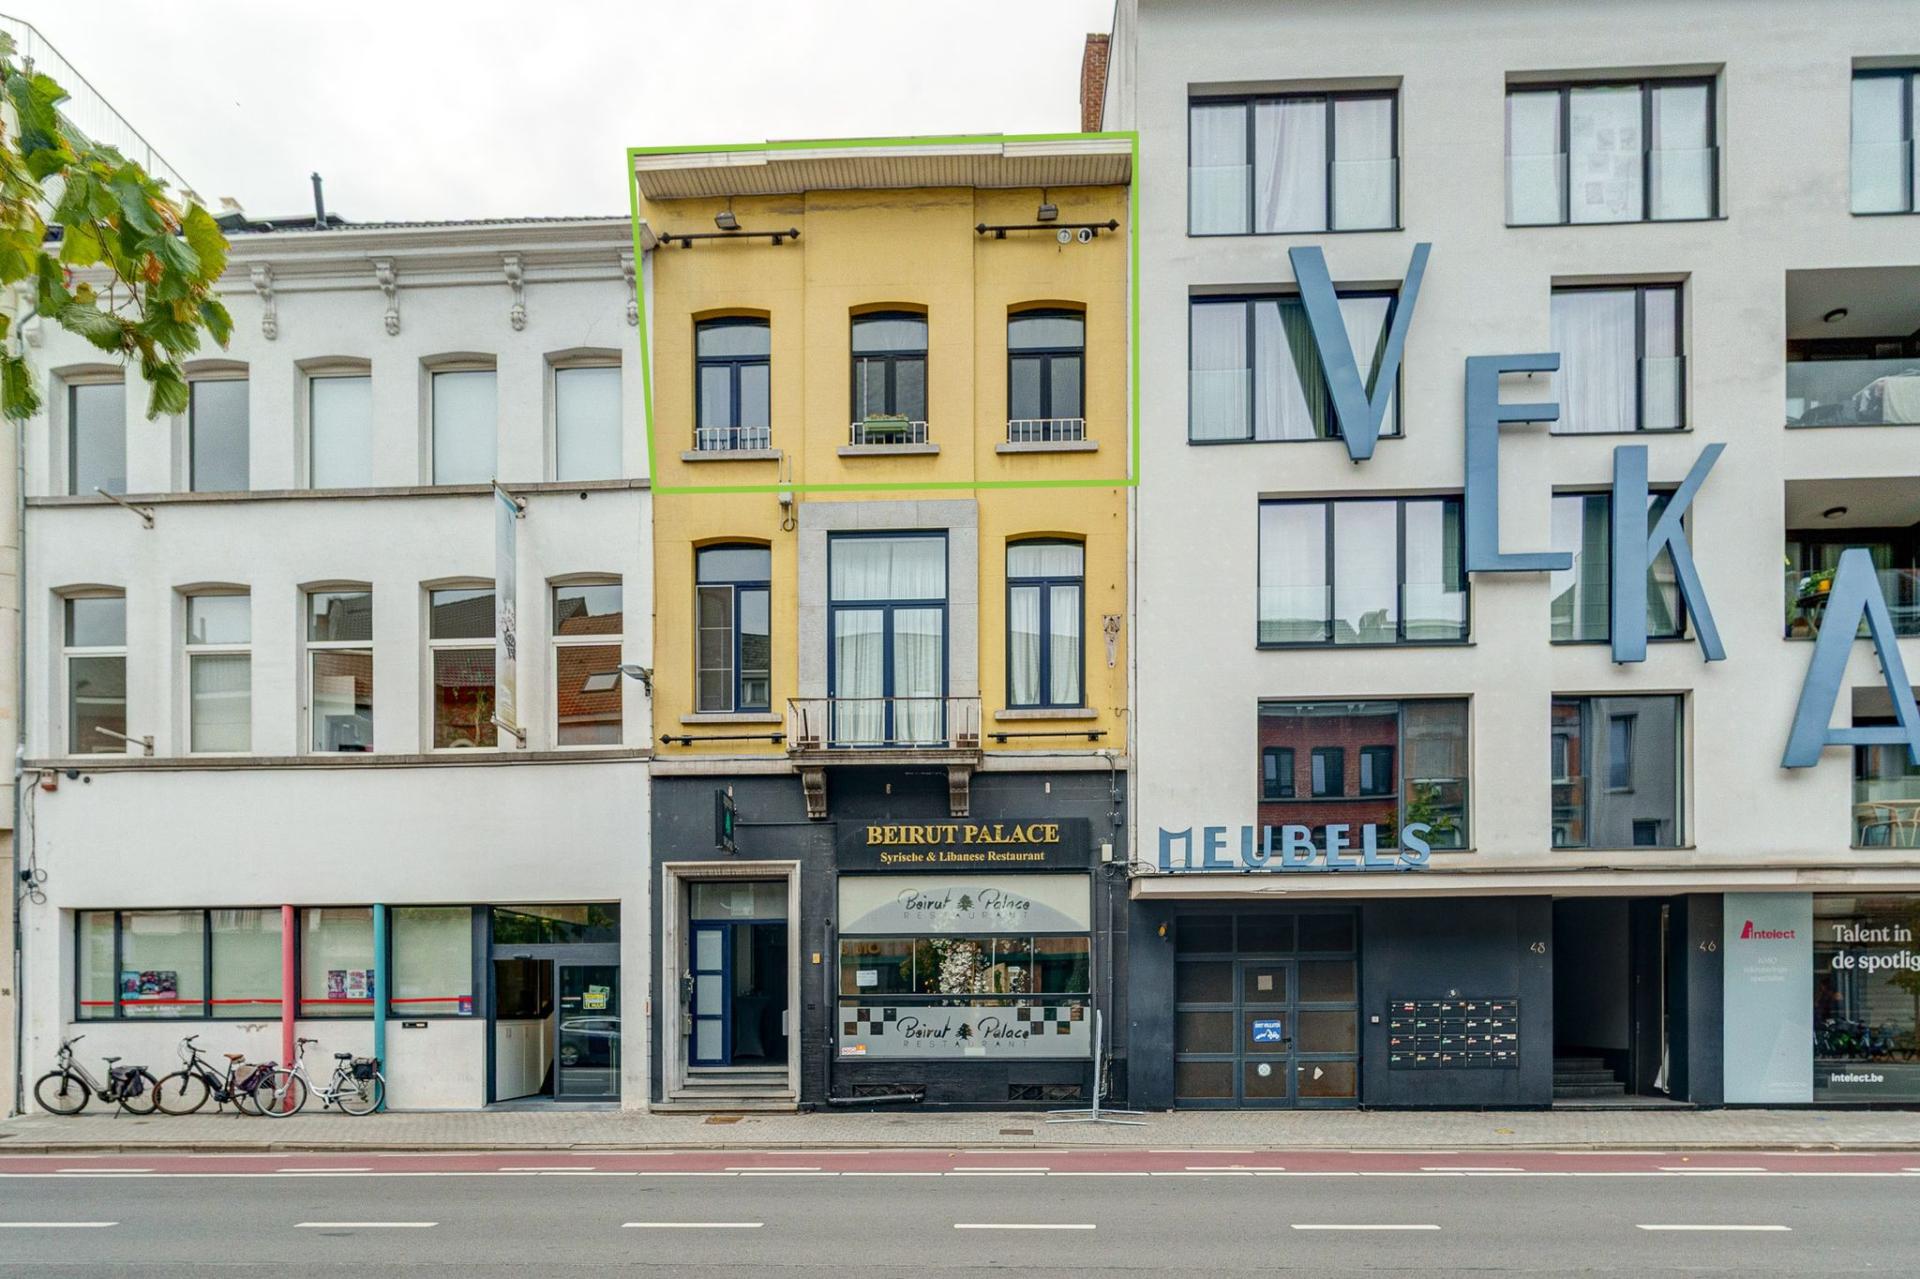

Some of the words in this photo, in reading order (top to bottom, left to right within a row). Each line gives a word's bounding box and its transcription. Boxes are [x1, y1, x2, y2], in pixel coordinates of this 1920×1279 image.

[1288, 243, 1920, 769] VEKA
[866, 825, 958, 844] BEIRUT
[963, 824, 1060, 843] PALACE
[1159, 823, 1432, 868] MEUBELS
[880, 852, 923, 864] Syrische
[927, 852, 936, 861] &
[939, 852, 984, 862] Libanese
[988, 851, 1045, 861] Restaurant
[897, 888, 952, 910] Beirut
[978, 888, 1031, 910] Palace
[1832, 923, 1890, 942] Talent
[1893, 924, 1912, 942] in
[1530, 941, 1546, 953] 48
[1699, 940, 1717, 952] 46
[1832, 950, 1855, 969] de
[1858, 950, 1920, 973] spotlig
[896, 1016, 951, 1039] Beirut
[977, 1016, 1031, 1039] Palace
[903, 1040, 1028, 1048] RESTAURANT
